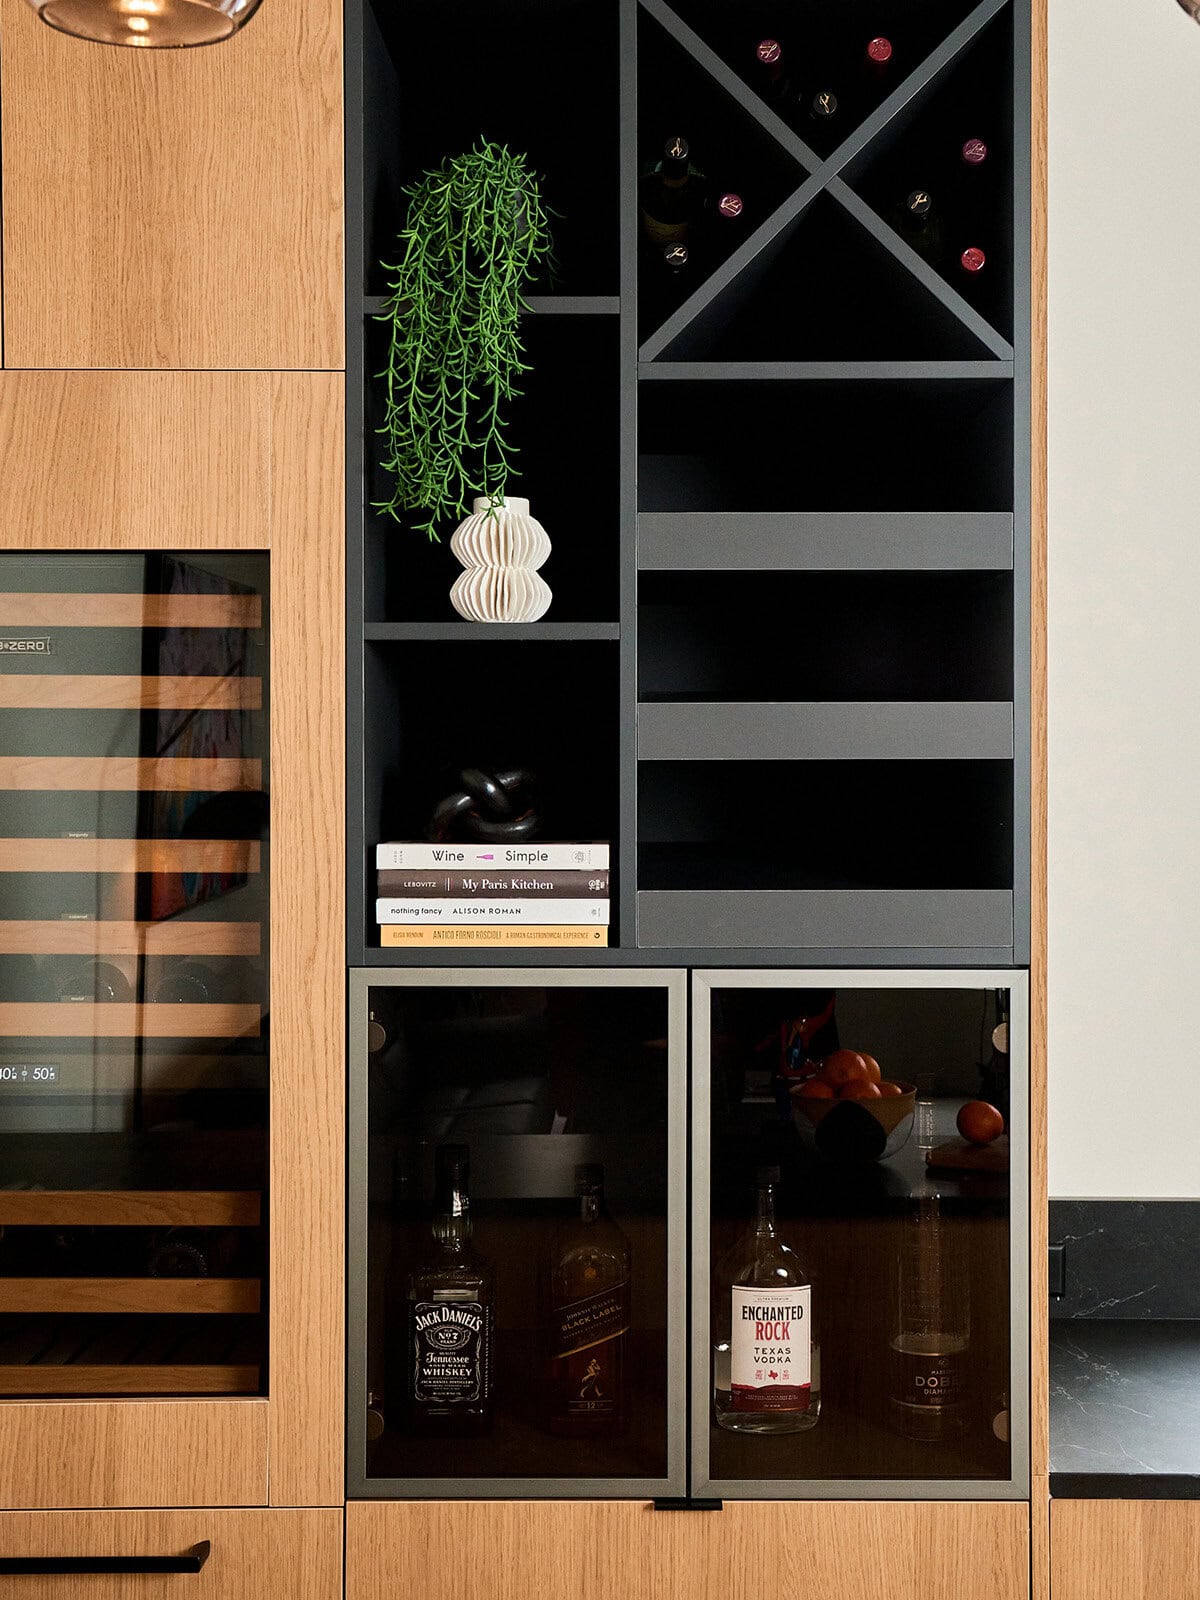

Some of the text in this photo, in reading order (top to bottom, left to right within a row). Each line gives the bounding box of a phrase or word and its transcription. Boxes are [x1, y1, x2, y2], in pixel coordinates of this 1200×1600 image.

[432, 850, 549, 864] Wine Simple
[462, 878, 554, 891] My Paris Kitchen
[390, 907, 443, 916] nothing fancy
[452, 907, 522, 915] ALISON ROMAN
[433, 930, 502, 940] ANTICO FORNO ROSCIOLI
[561, 1317, 591, 1332] BLACK
[593, 1304, 624, 1320] LABEL
[741, 1305, 804, 1321] ENCHANTED
[415, 1307, 483, 1332] JACK DANIEL'S
[755, 1321, 791, 1341] ROCK
[754, 1347, 792, 1355] TEXAS
[426, 1352, 470, 1364] Tennessee
[754, 1356, 792, 1364] VODKA
[423, 1368, 472, 1376] WHISKEY
